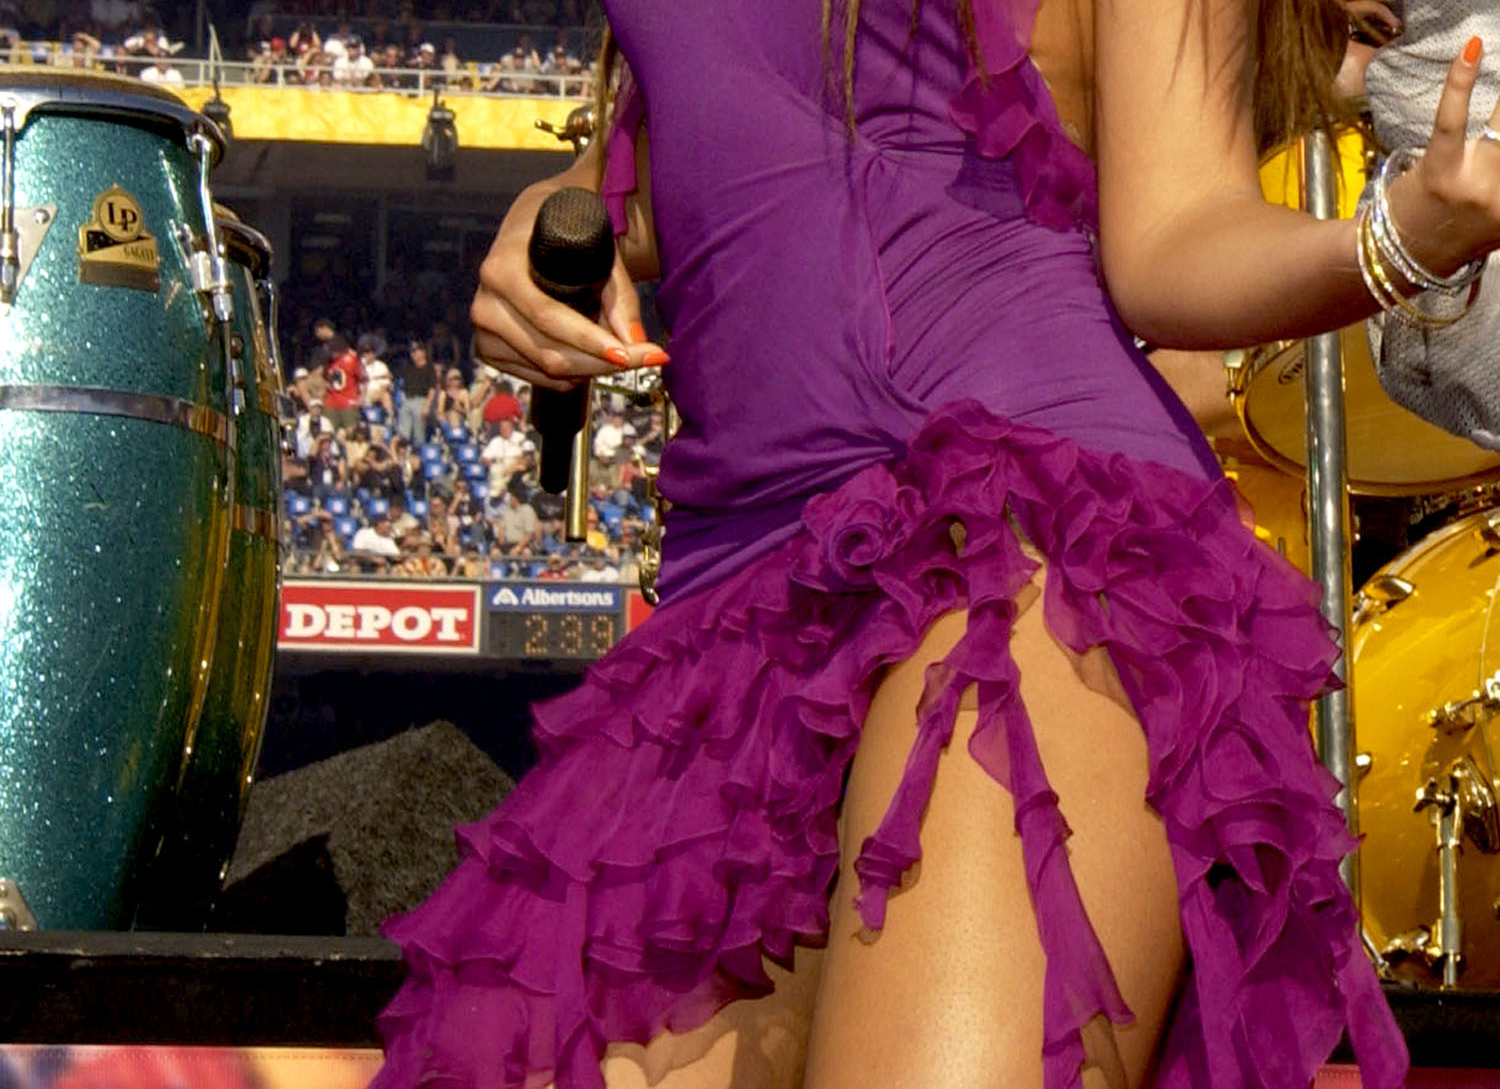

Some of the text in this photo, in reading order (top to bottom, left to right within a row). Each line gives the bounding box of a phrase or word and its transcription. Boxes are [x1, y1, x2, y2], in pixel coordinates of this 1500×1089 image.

[108, 202, 138, 231] LP
[521, 587, 614, 606] Albertsons
[284, 603, 468, 641] DEPOT
